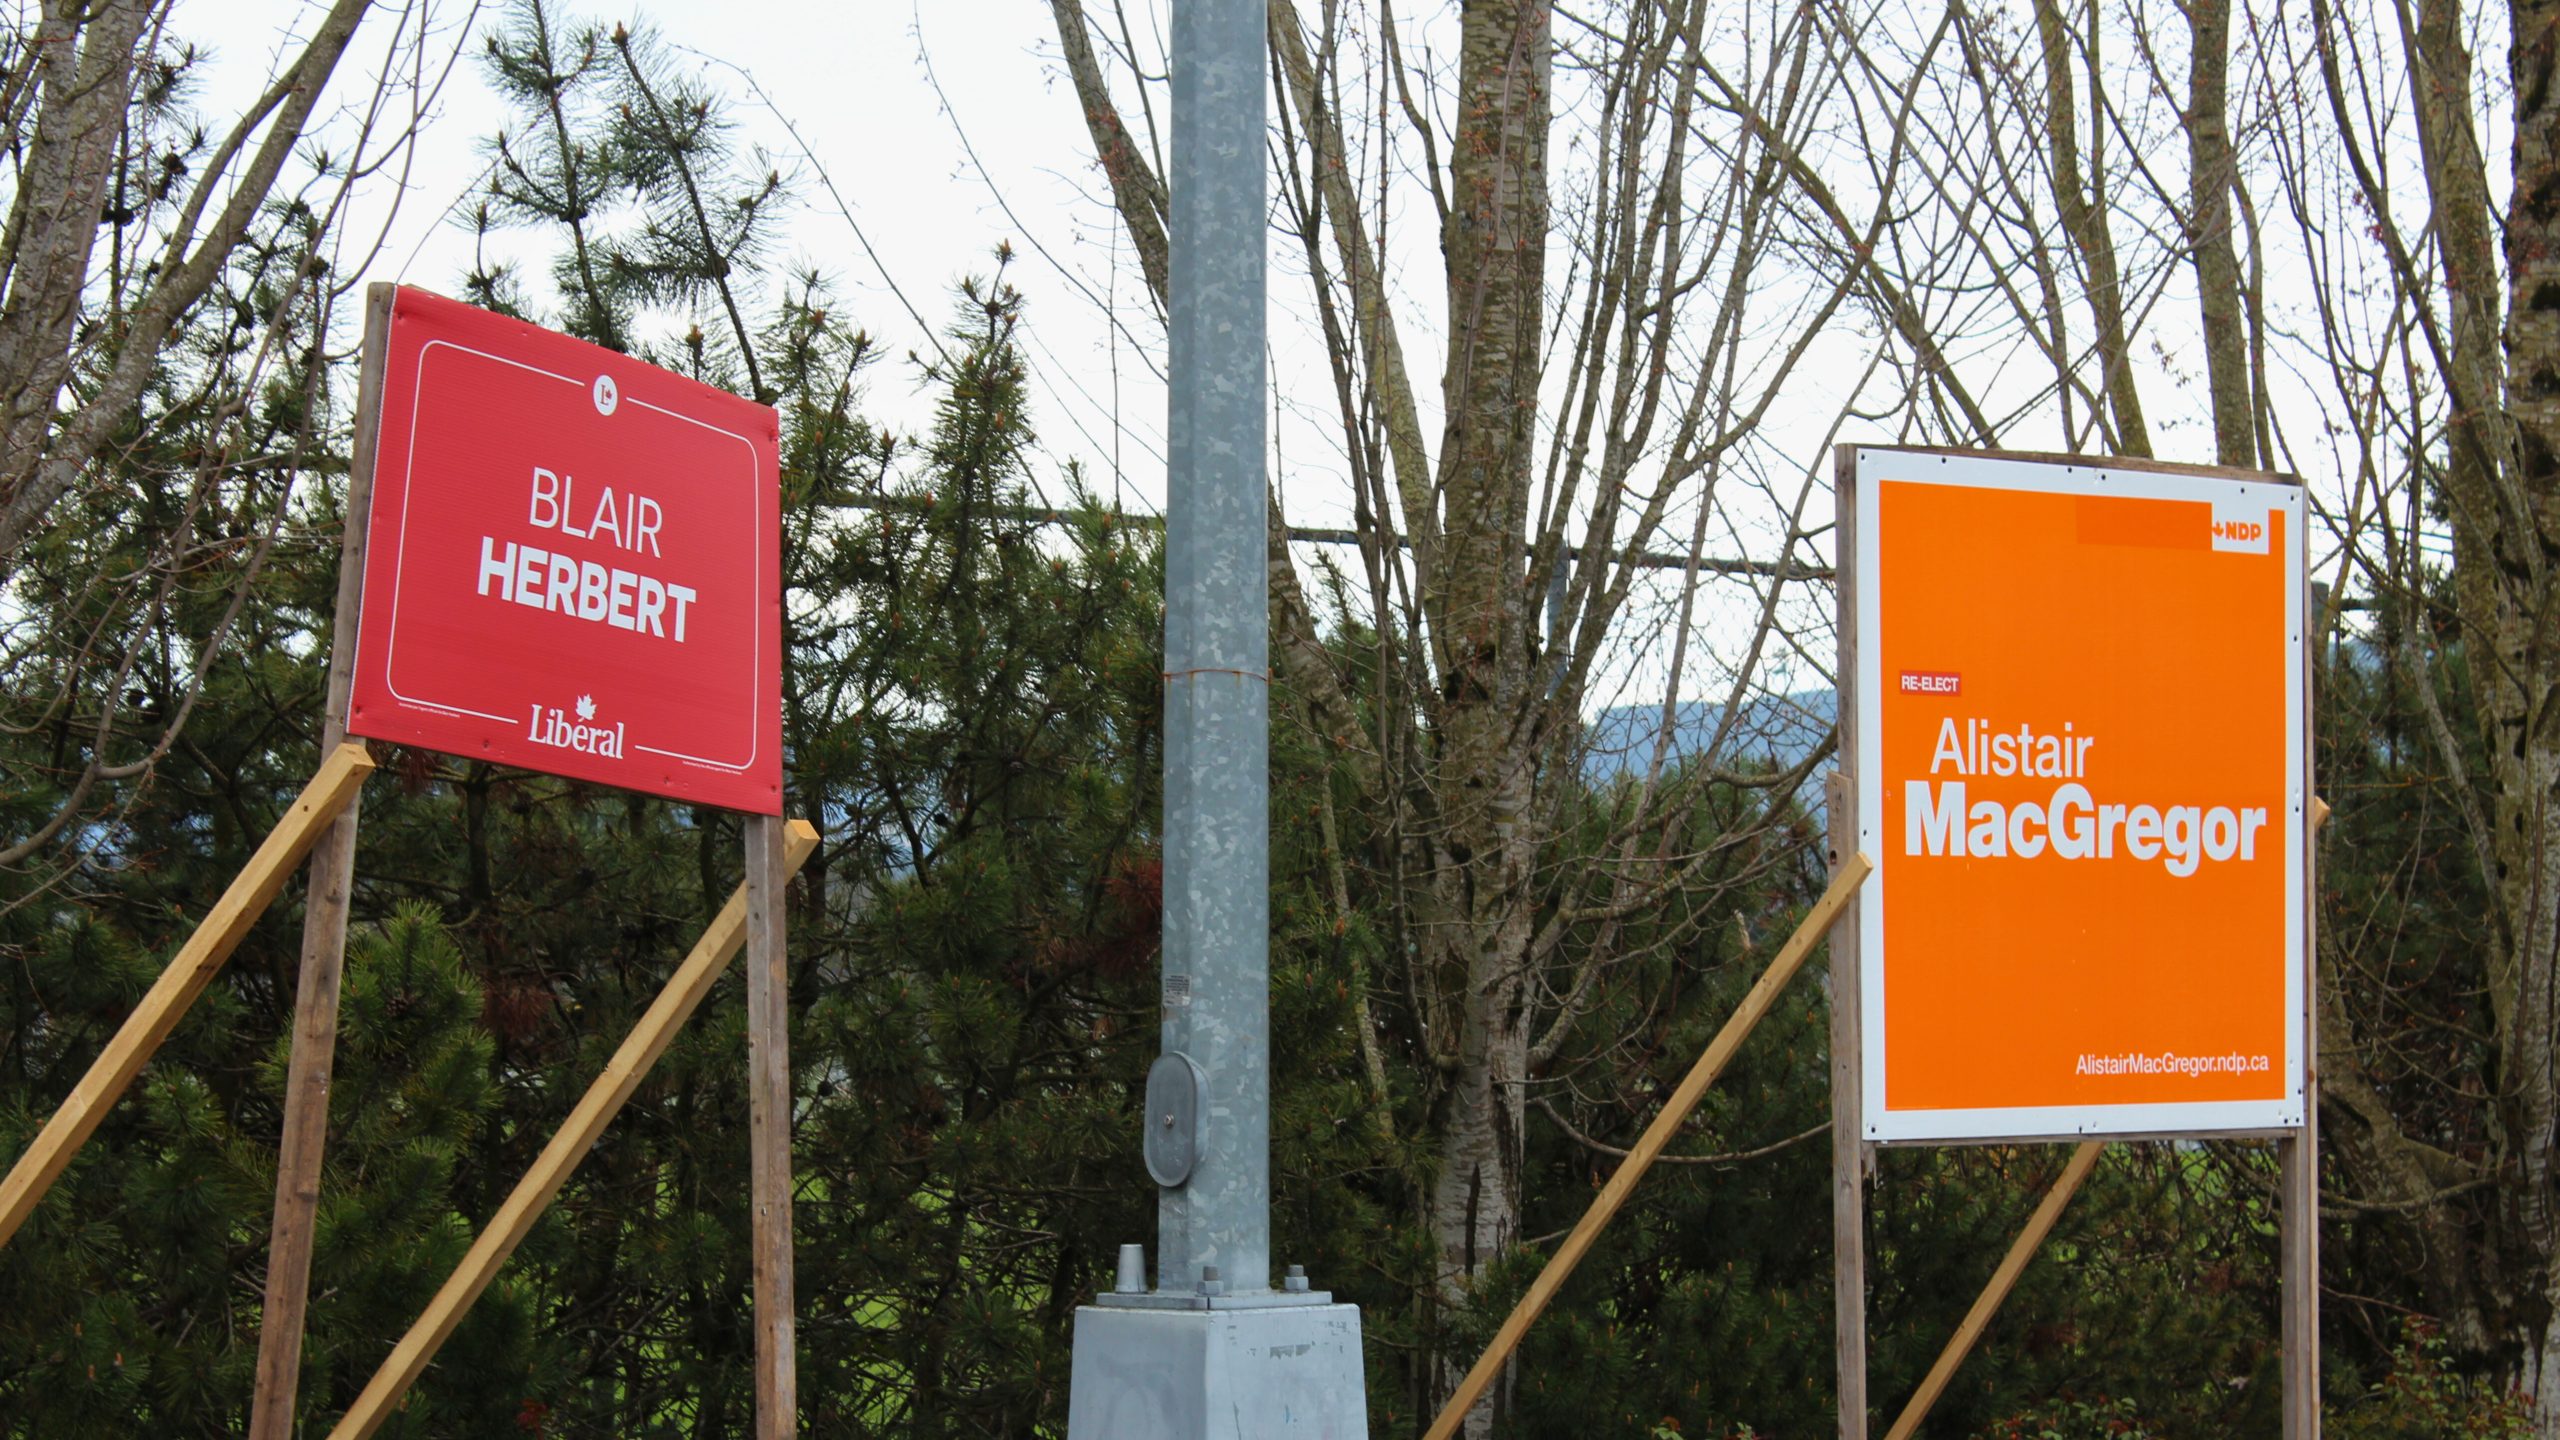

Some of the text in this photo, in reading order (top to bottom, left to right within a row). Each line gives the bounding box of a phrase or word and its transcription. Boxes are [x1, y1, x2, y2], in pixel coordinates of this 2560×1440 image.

[529, 466, 663, 559] BLAIR
[2225, 521, 2262, 541] NDP
[477, 535, 697, 643] HERBERT
[1901, 675, 1959, 692] RE-ELECT
[527, 703, 625, 760] Liberal
[1929, 717, 2096, 779] Alistair
[1904, 779, 2268, 878] MacGregor
[2075, 1051, 2270, 1078] AlistairMacGregor.ndp.ca
